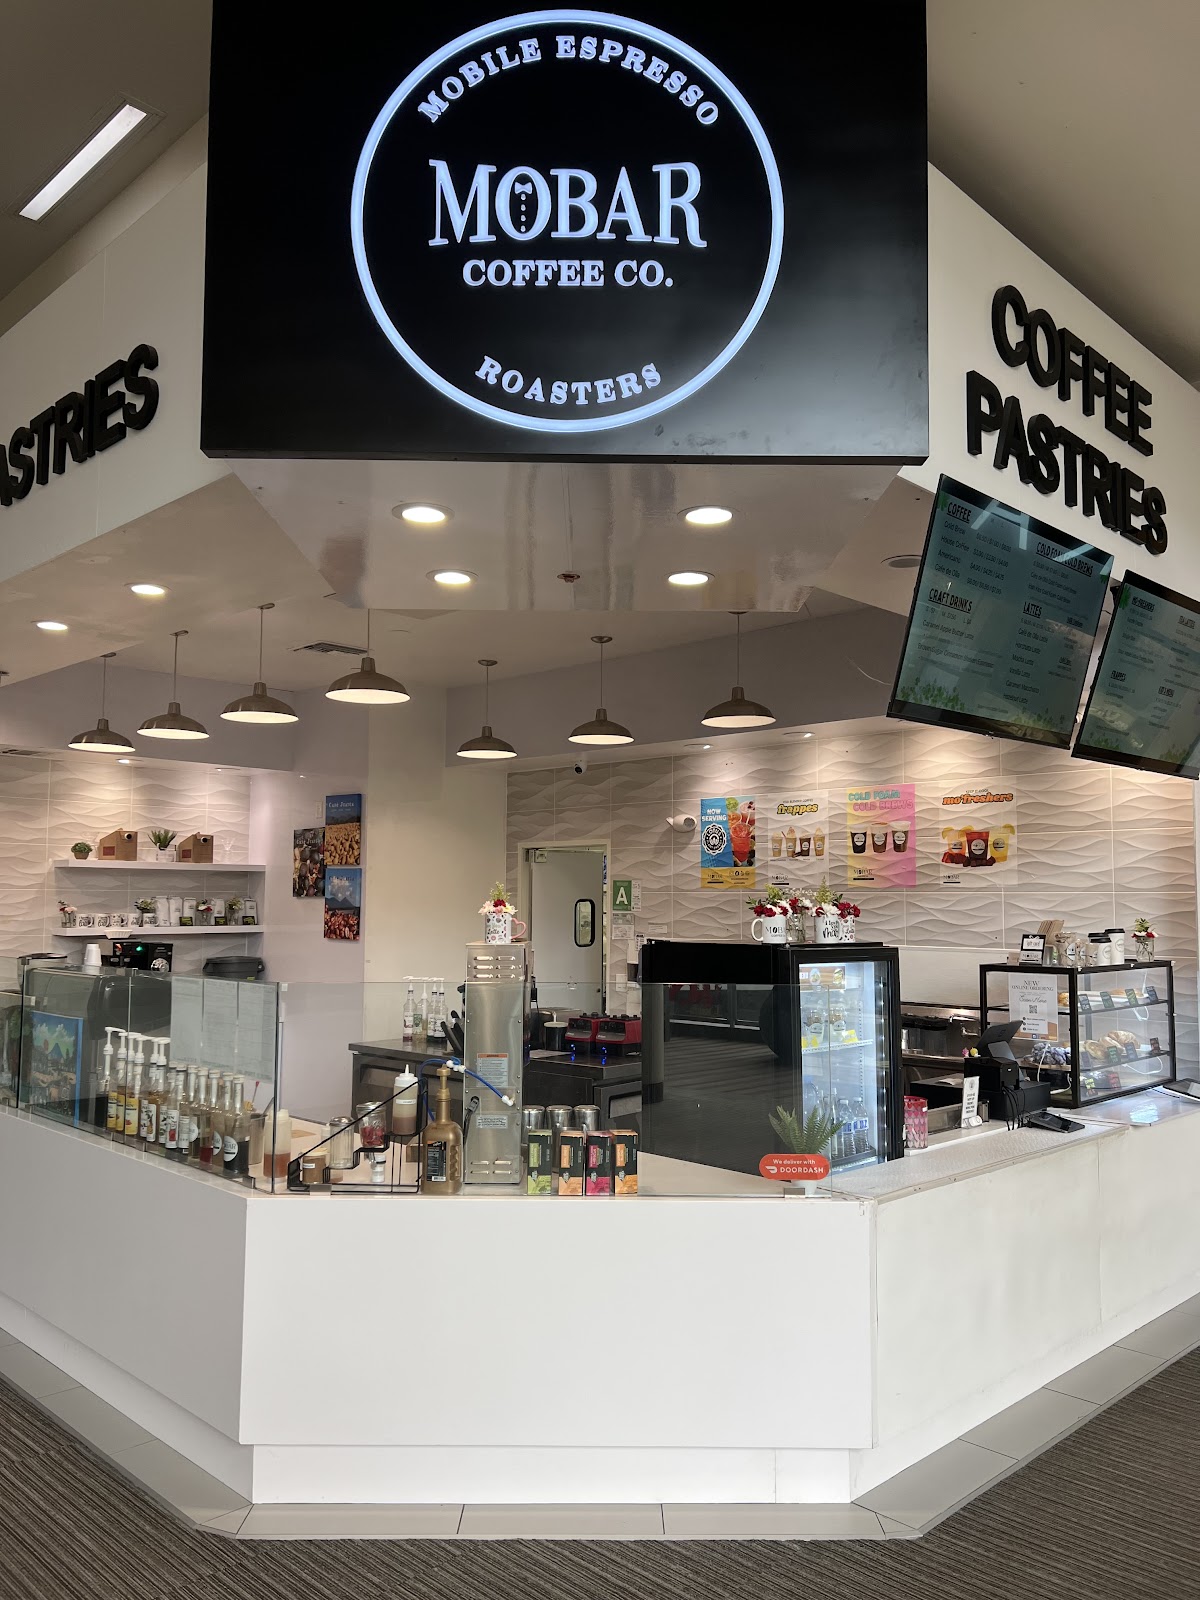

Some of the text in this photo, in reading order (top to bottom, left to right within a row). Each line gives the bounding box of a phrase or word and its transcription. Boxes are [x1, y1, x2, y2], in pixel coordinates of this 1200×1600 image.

[417, 35, 719, 125] MOBILE ESPRESSO
[428, 159, 708, 247] MOBAR
[463, 259, 673, 286] COFFEE CO.
[475, 355, 662, 406] ROASTERS
[991, 285, 1153, 457] COFFEE
[966, 370, 1168, 555] PASTRIES
[947, 501, 971, 521] COFFEE
[1036, 542, 1051, 556] COLD
[928, 588, 972, 612] CRAFT DRINKS
[1023, 602, 1042, 616] LATTES
[848, 790, 900, 801] COLD FOAM
[853, 800, 914, 811] COLD BREWS
[776, 803, 818, 816] frappes
[616, 886, 628, 905] A
